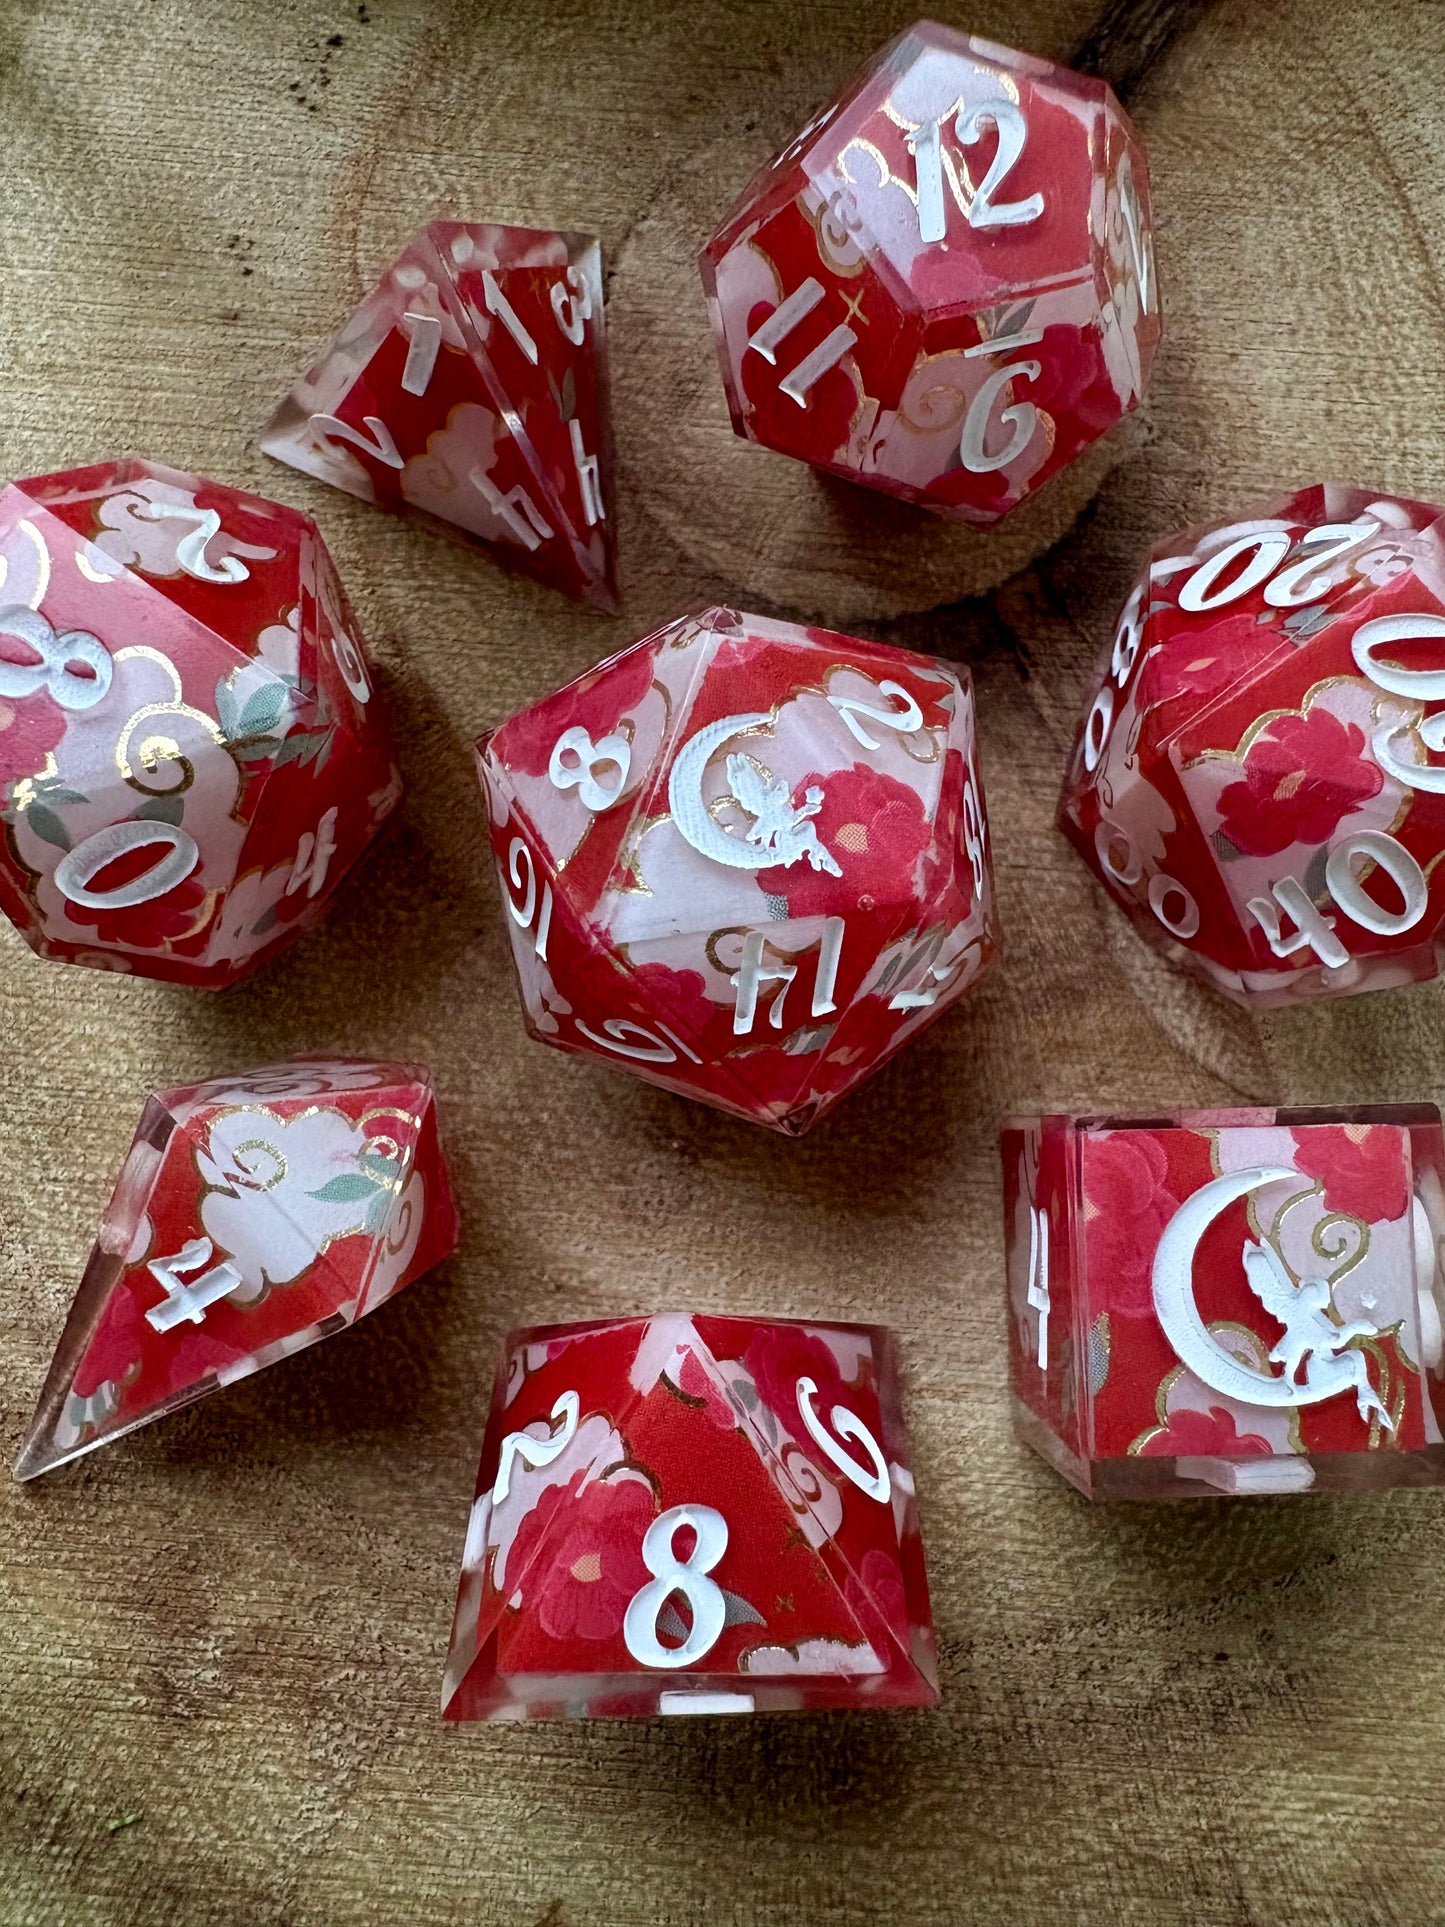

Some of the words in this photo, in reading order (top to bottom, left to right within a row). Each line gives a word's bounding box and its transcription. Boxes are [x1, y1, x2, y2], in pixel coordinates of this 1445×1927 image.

[904, 99, 1044, 243] 12
[748, 276, 858, 410] 11
[0, 603, 113, 710] 8
[549, 725, 631, 811] 8
[825, 679, 924, 751] 2
[54, 819, 199, 910] 0
[1246, 829, 1429, 970] 40
[145, 1236, 244, 1335] 4
[623, 1503, 729, 1669] 8
